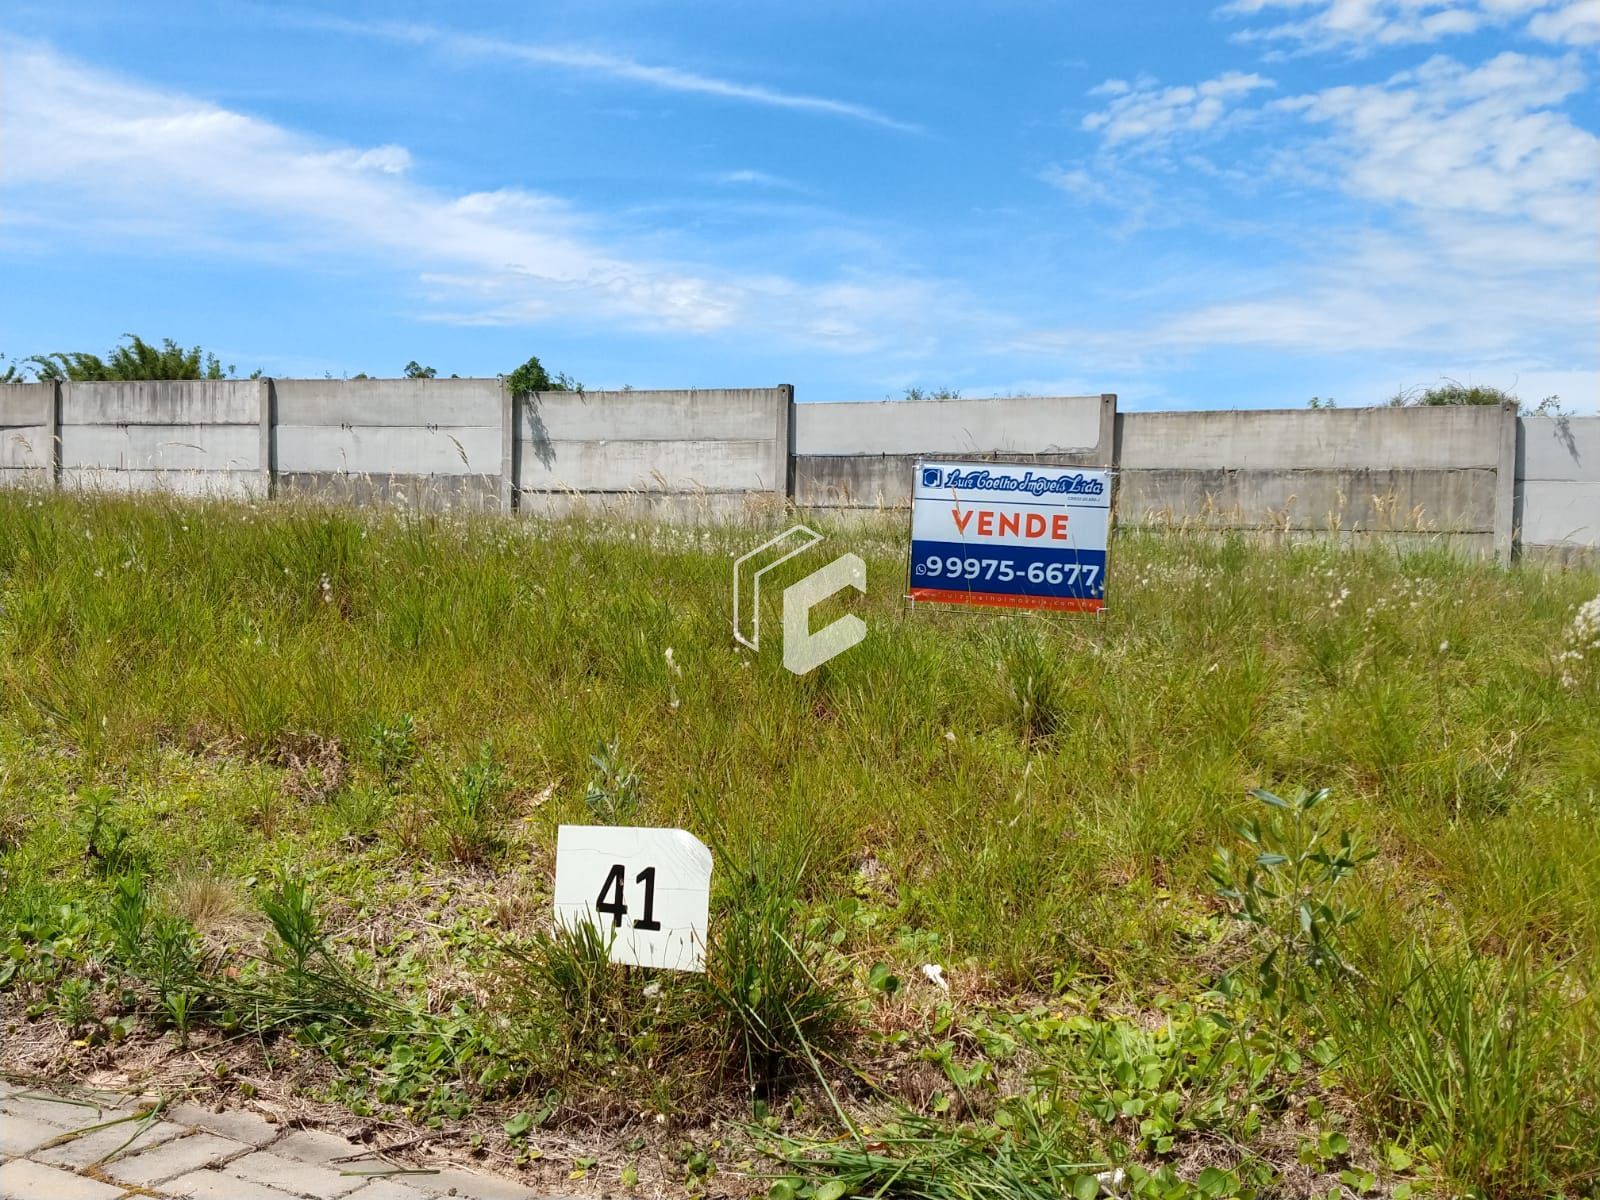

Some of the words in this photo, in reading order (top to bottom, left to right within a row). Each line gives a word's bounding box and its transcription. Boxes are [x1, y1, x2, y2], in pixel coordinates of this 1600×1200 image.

[945, 468, 973, 489] Luiz
[967, 470, 1018, 490] Coelho
[952, 510, 1069, 540] VENDE
[596, 864, 661, 932] 41
